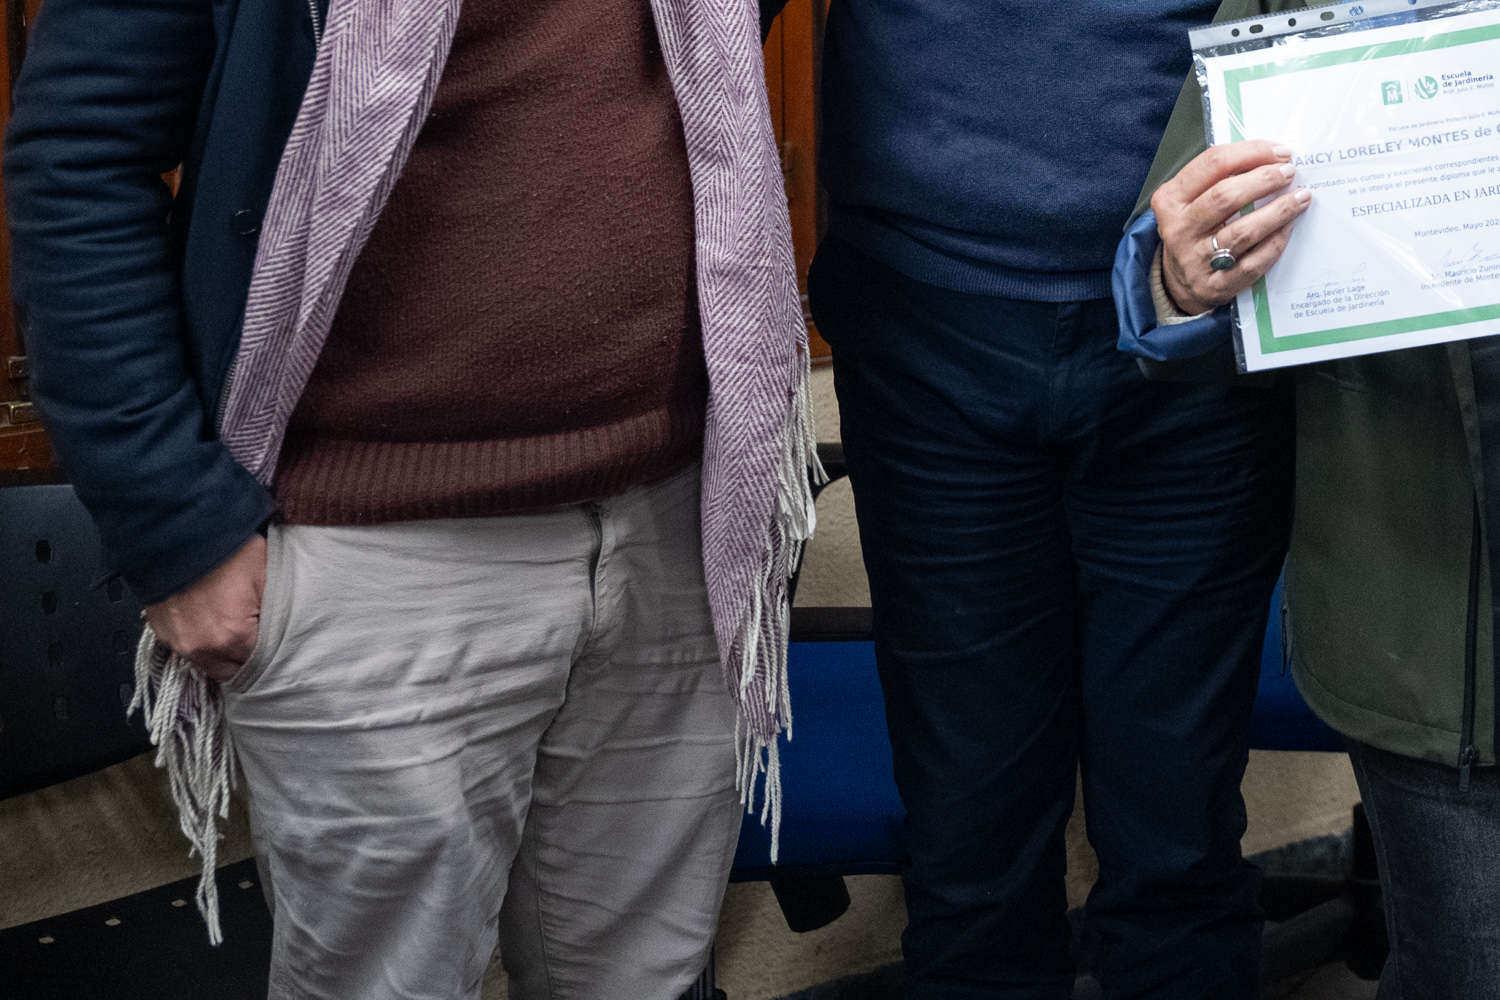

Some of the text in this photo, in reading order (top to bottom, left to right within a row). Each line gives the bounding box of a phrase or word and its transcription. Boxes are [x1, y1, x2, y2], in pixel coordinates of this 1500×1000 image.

[1441, 70, 1472, 81] Escuela
[1442, 73, 1494, 88] de Jardinería
[1339, 140, 1402, 160] LORELEY
[1408, 129, 1469, 148] MONTES
[1474, 126, 1492, 138] de
[1309, 178, 1346, 191] aprobado
[1347, 176, 1358, 184] los
[1360, 172, 1385, 182] cursos
[1393, 164, 1433, 177] exámenes
[1434, 153, 1500, 171] correspondientes
[1359, 186, 1367, 194] le
[1368, 181, 1393, 193] otorga
[1395, 180, 1403, 188] el
[1404, 175, 1438, 188] presente
[1439, 170, 1470, 182] diploma
[1472, 167, 1487, 177] que
[1488, 165, 1495, 174] le
[1351, 193, 1451, 218] ESPECIALIZADA
[1454, 189, 1471, 202] EN
[1414, 224, 1461, 238] Montevideo,
[1462, 221, 1484, 232] Mayo
[1444, 267, 1477, 279] Mauricio
[1323, 286, 1345, 298] Javier
[1347, 284, 1366, 294] Lage
[1421, 277, 1463, 291] Intendente
[1463, 275, 1474, 285] de
[1290, 288, 1390, 311] Encargado de la Dirección
[1293, 298, 1385, 319] de Escuela de Jardinería
